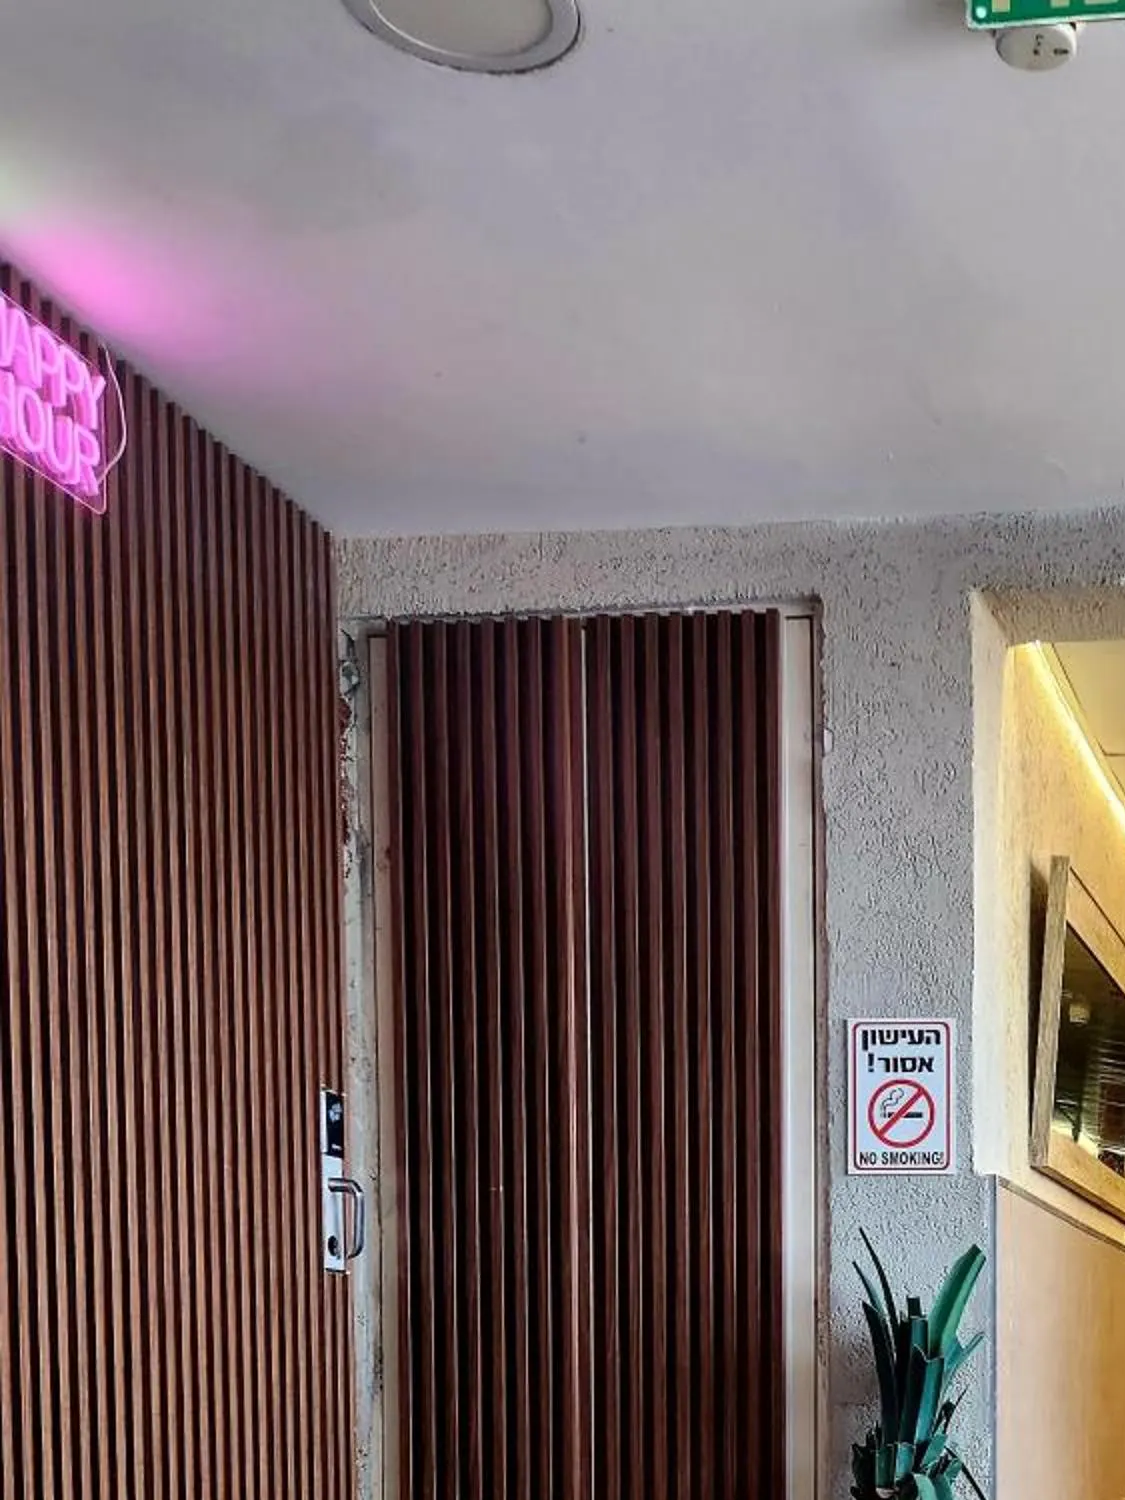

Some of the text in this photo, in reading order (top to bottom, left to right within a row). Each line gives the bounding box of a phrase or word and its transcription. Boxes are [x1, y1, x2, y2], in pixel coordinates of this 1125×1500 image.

[0, 295, 106, 430] APPY
[861, 1029, 942, 1051] העישון
[867, 1053, 934, 1073] אסור!
[859, 1151, 877, 1165] NO
